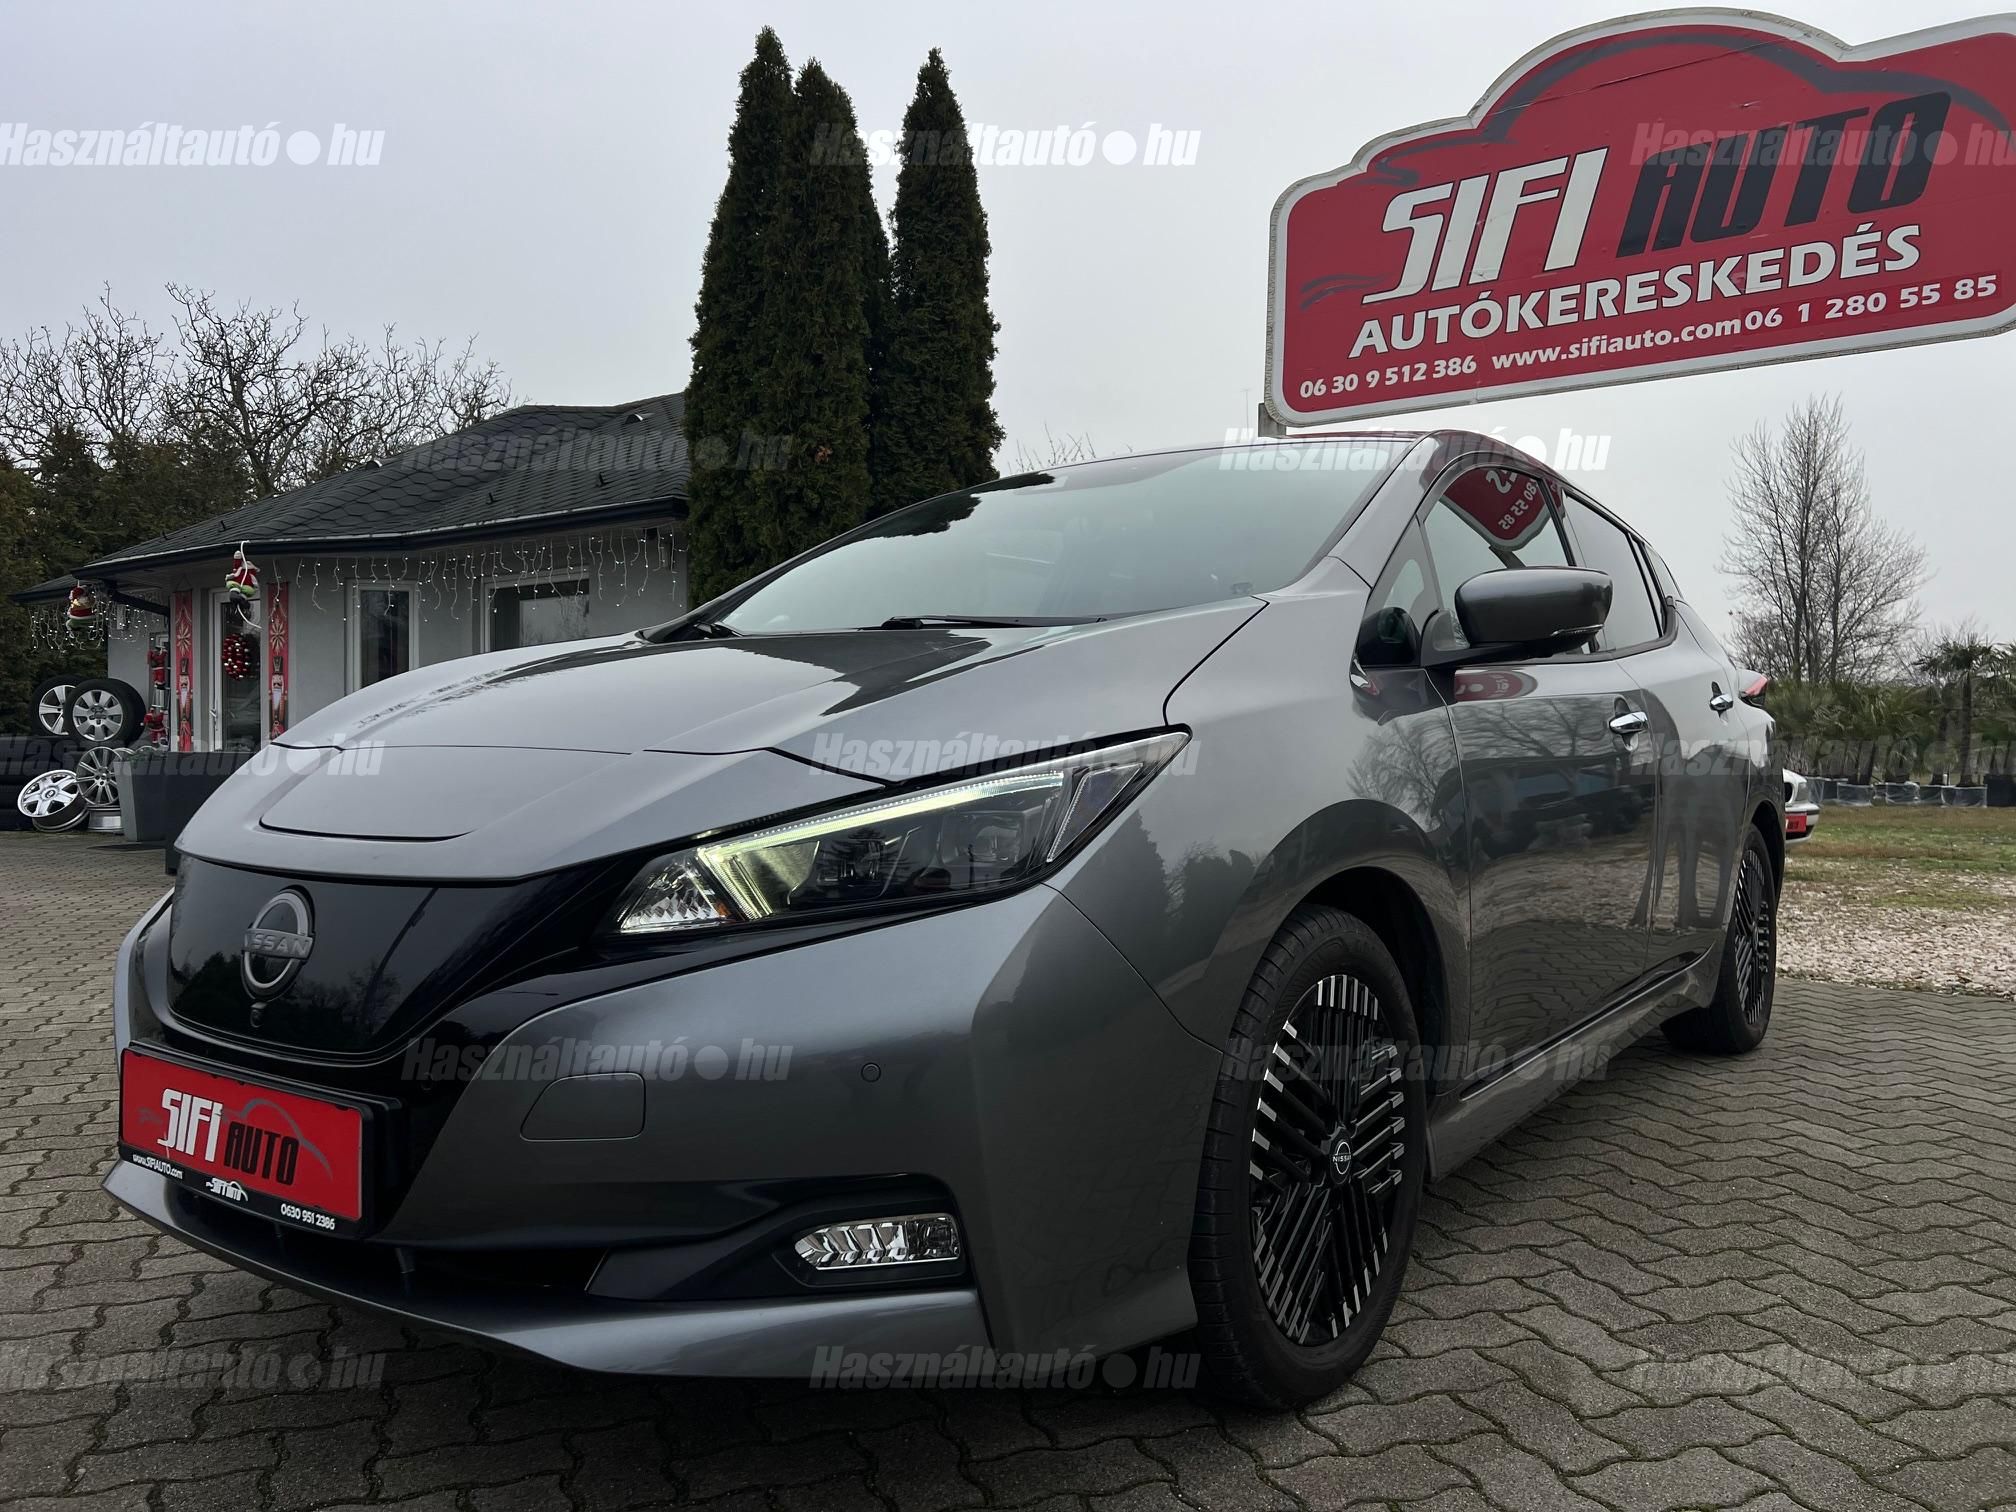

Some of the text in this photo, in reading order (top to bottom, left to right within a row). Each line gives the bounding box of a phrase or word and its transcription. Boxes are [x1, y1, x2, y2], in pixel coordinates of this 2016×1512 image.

[1361, 91, 1951, 305] SIFI AUTO
[1300, 275, 1997, 398] 06 30 9 512 386 www.sifiauto.com 06 1 280 55 85
[1348, 222, 1921, 359] AUTÓKERESKEDÉS
[157, 1088, 299, 1186] SIFI AUTO
[281, 1203, 335, 1230] 0630 951 2386
